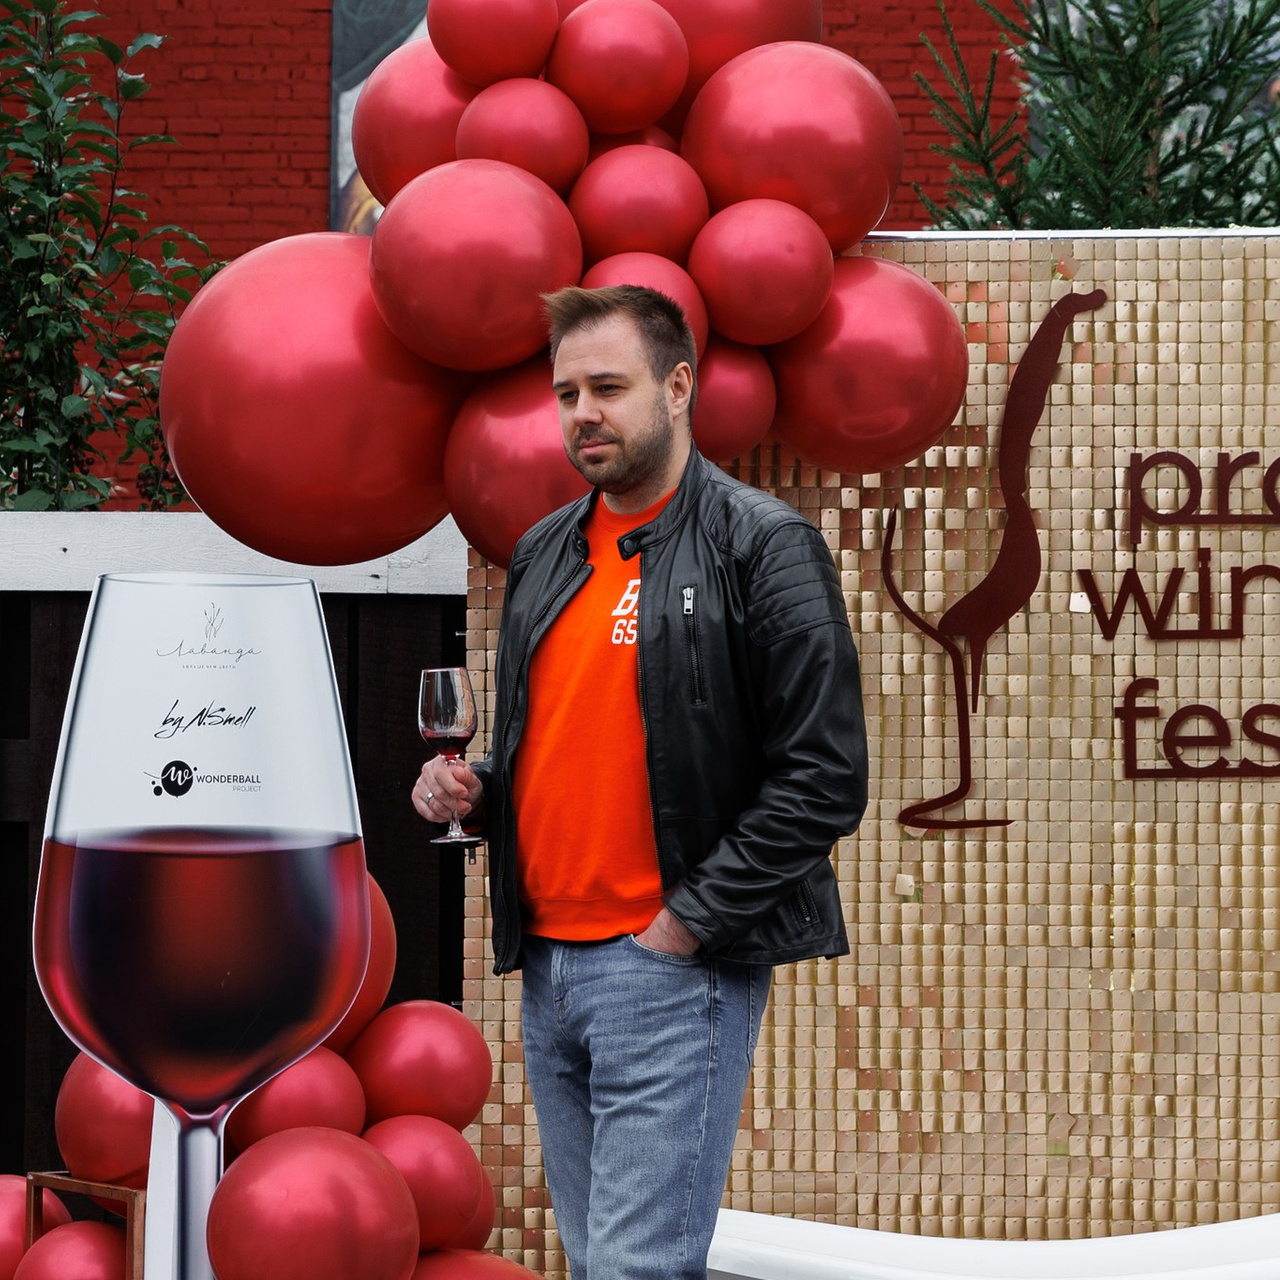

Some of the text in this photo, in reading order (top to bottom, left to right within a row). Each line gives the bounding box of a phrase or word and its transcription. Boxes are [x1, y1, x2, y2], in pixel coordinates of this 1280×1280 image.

[1130, 451, 1280, 544] pr
[154, 699, 257, 739] by N.Smell
[196, 774, 261, 784] WONDERBALL
[232, 785, 261, 793] PROJECT
